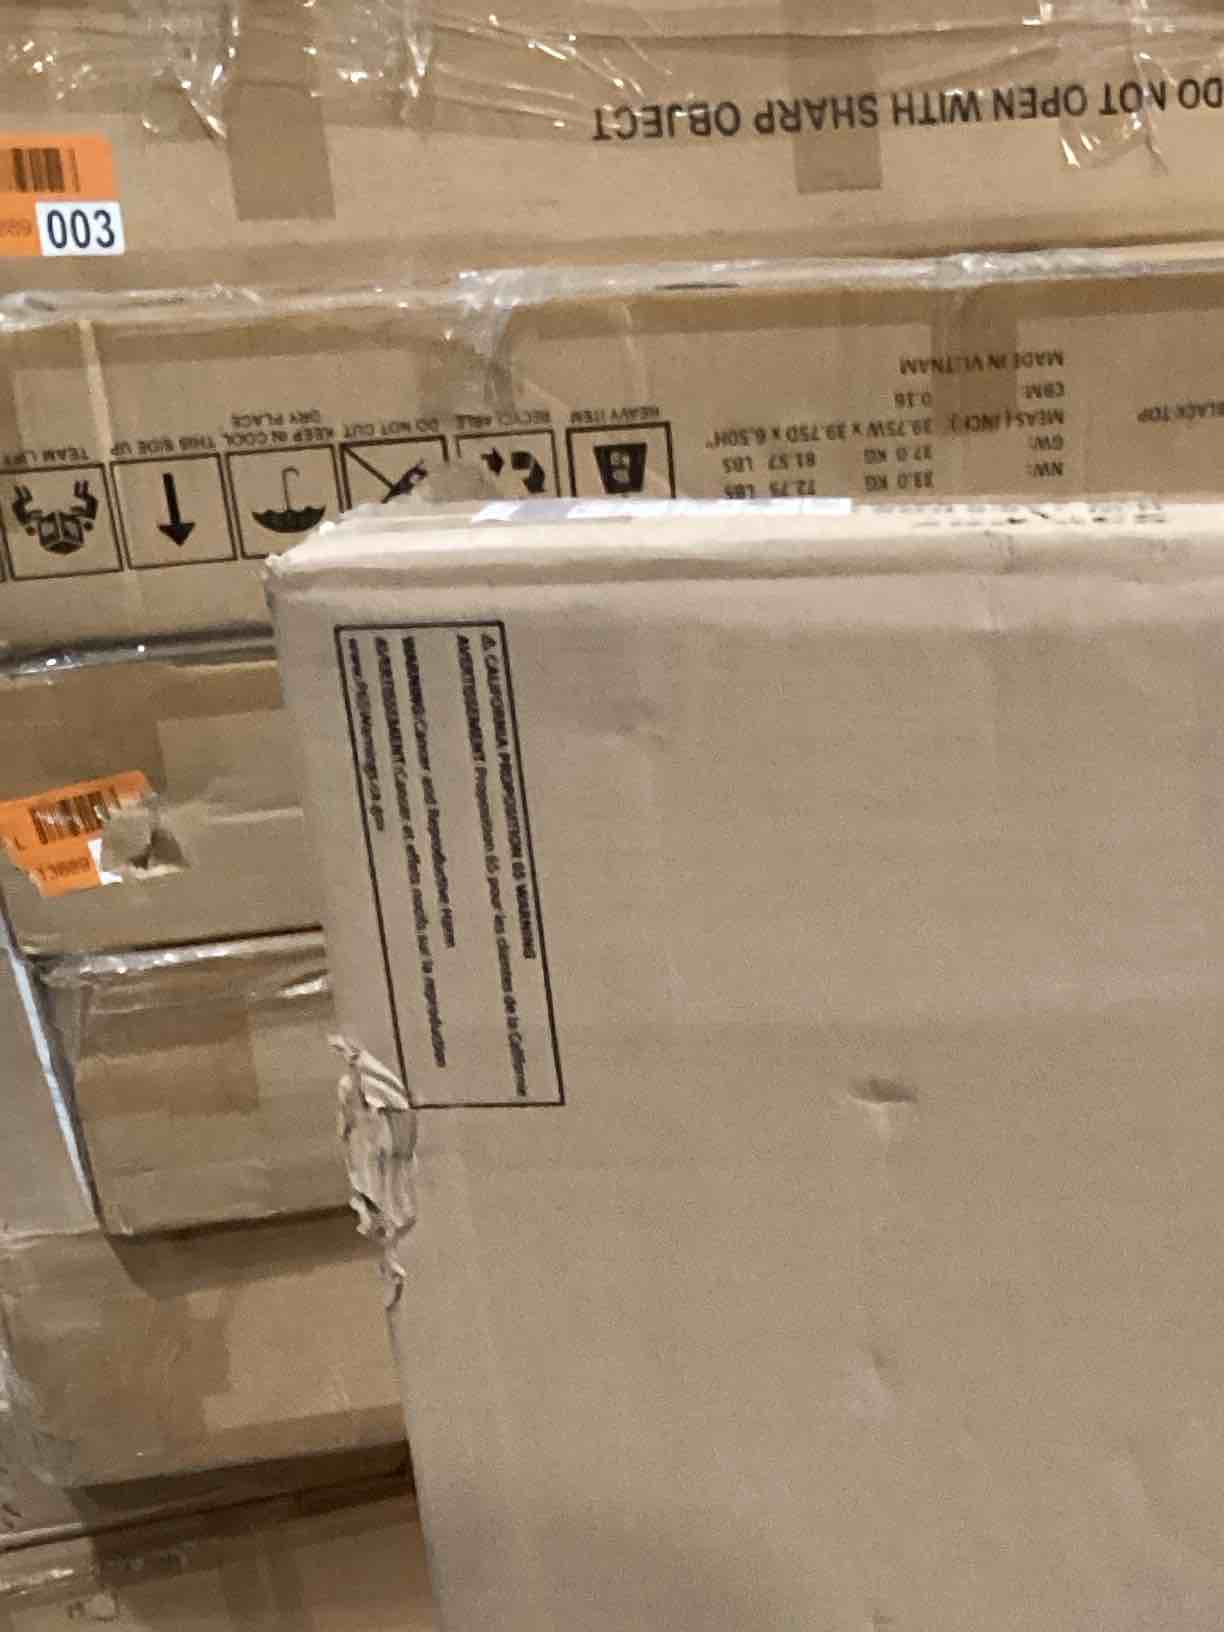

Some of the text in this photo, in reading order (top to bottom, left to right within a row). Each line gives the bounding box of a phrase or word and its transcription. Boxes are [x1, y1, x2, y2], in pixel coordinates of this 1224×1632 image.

[592, 77, 1224, 141] DO NOT OPEN WITH SHARP OBJECT
[47, 209, 115, 249] 003
[1015, 351, 1065, 368] MADE
[611, 406, 660, 421] HEAVY
[422, 776, 438, 804] and
[484, 654, 537, 959] CALIFORNIA PROPOSITION 65 WARNING
[427, 808, 450, 903] Reproductive
[423, 976, 447, 1068] reproduction
